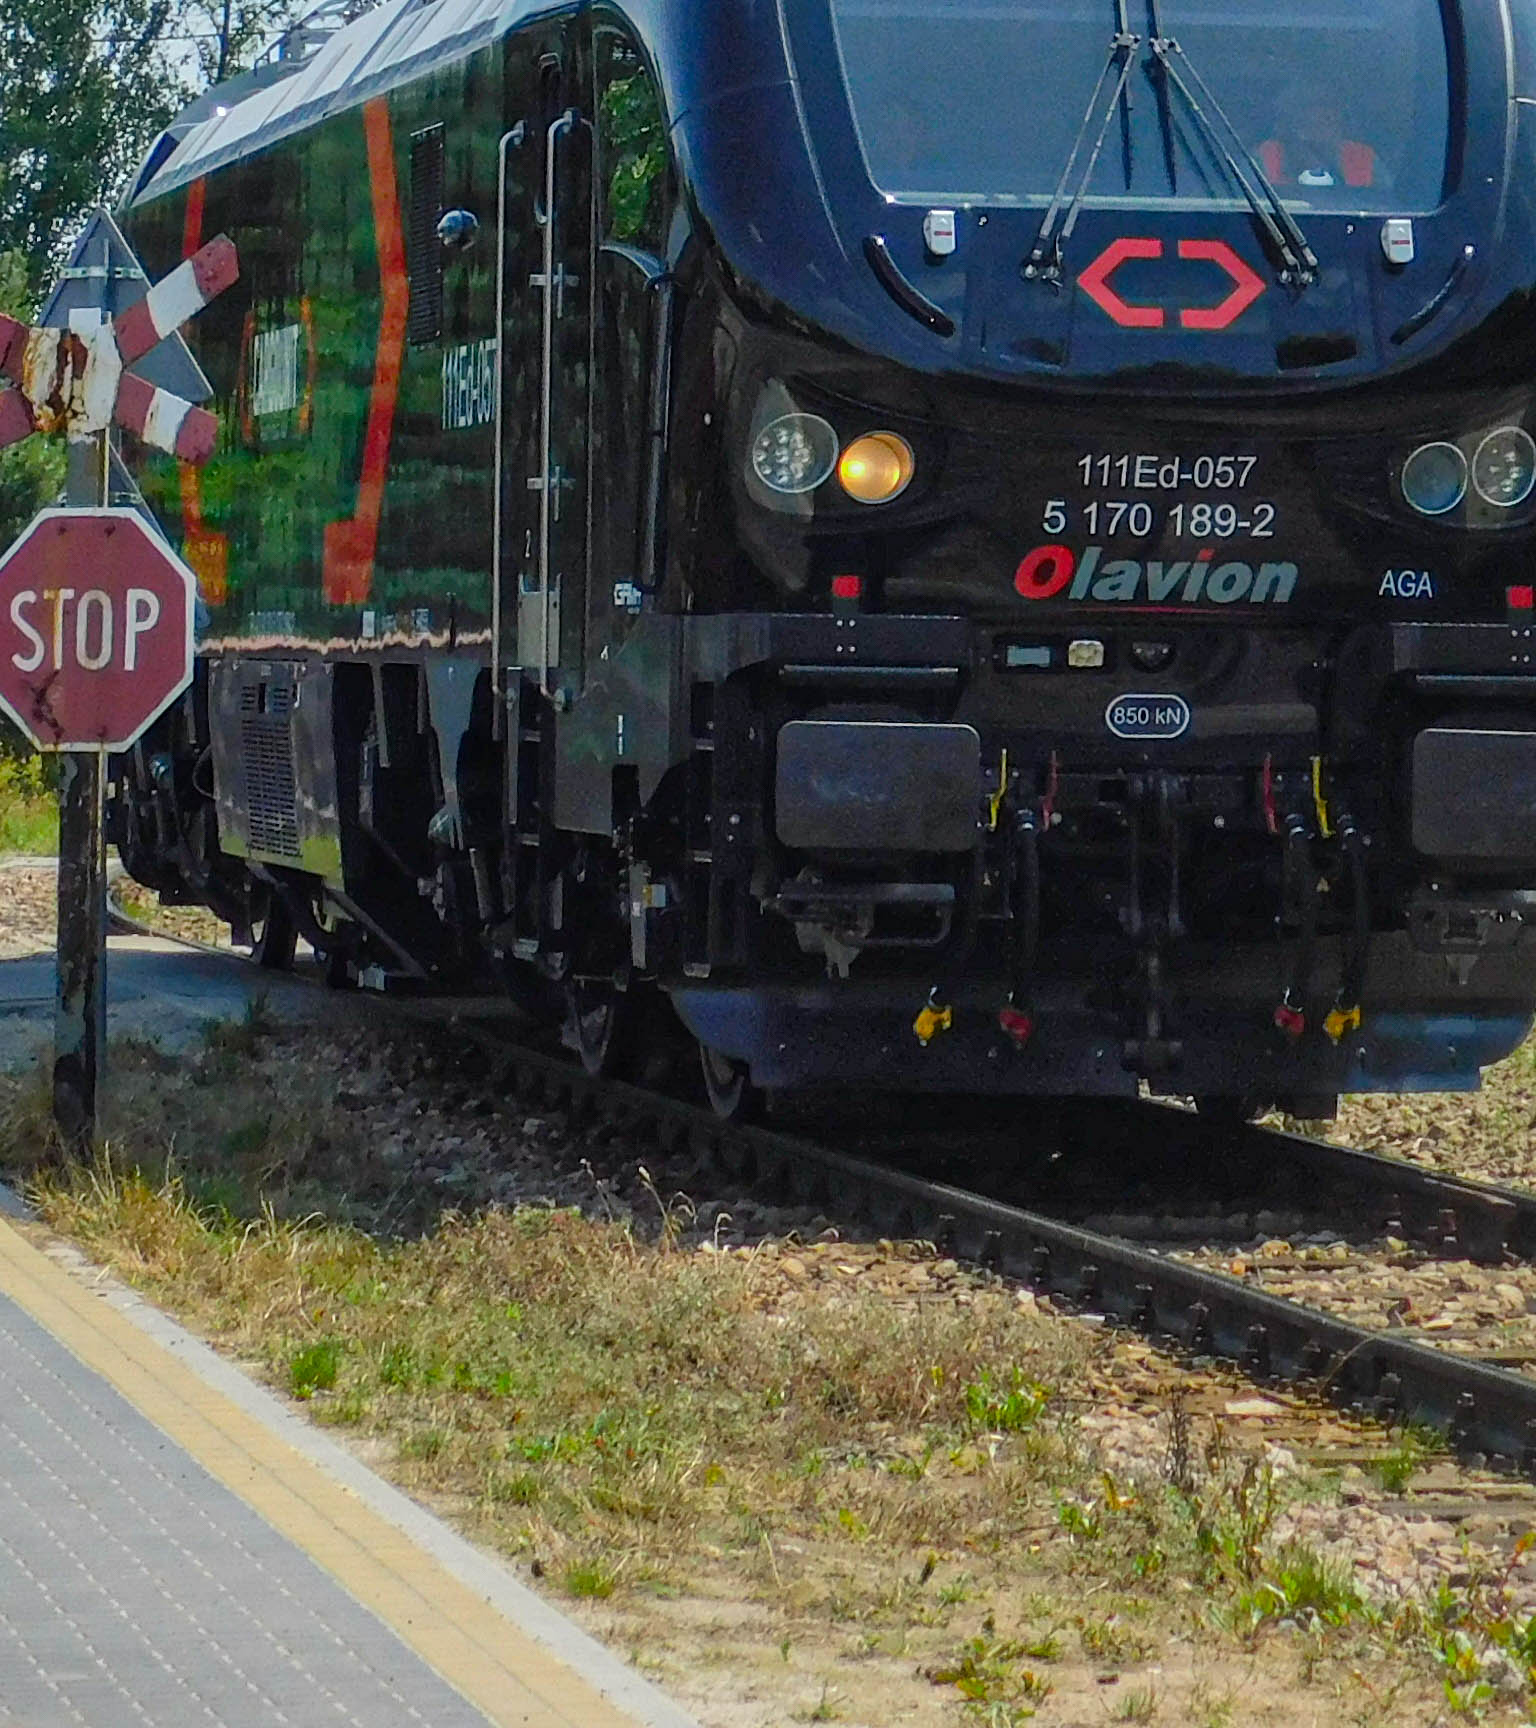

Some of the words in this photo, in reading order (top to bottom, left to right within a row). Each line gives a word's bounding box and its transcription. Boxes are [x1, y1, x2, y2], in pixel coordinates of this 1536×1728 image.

[1078, 454, 1258, 488] 111Ed-057
[1042, 500, 1066, 534] 5
[1082, 501, 1153, 536] 170
[1168, 503, 1275, 537] 189-2
[1014, 543, 1299, 603] Olavion
[1378, 569, 1433, 598] AGA
[10, 587, 161, 672] STOP
[1113, 706, 1150, 725] 850
[1155, 706, 1181, 725] kN
